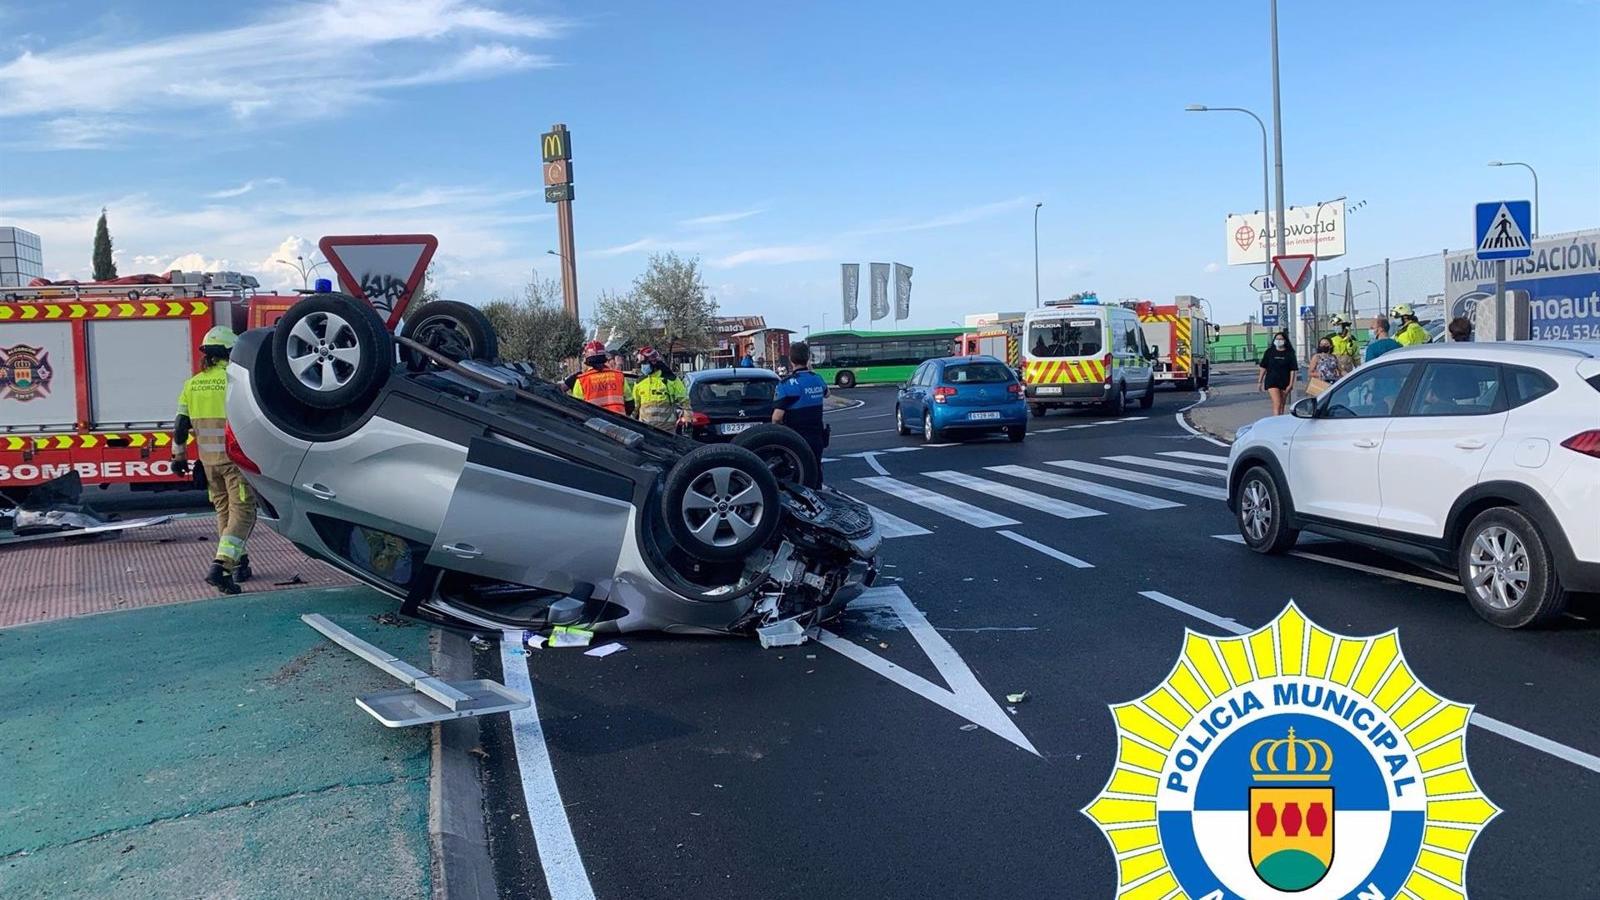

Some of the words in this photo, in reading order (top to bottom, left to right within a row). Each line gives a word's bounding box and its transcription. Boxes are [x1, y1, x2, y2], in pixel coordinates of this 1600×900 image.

[1258, 219, 1336, 241] AuoWorld
[1450, 255, 1495, 283] MÁXIM
[1544, 325, 1569, 341] 494
